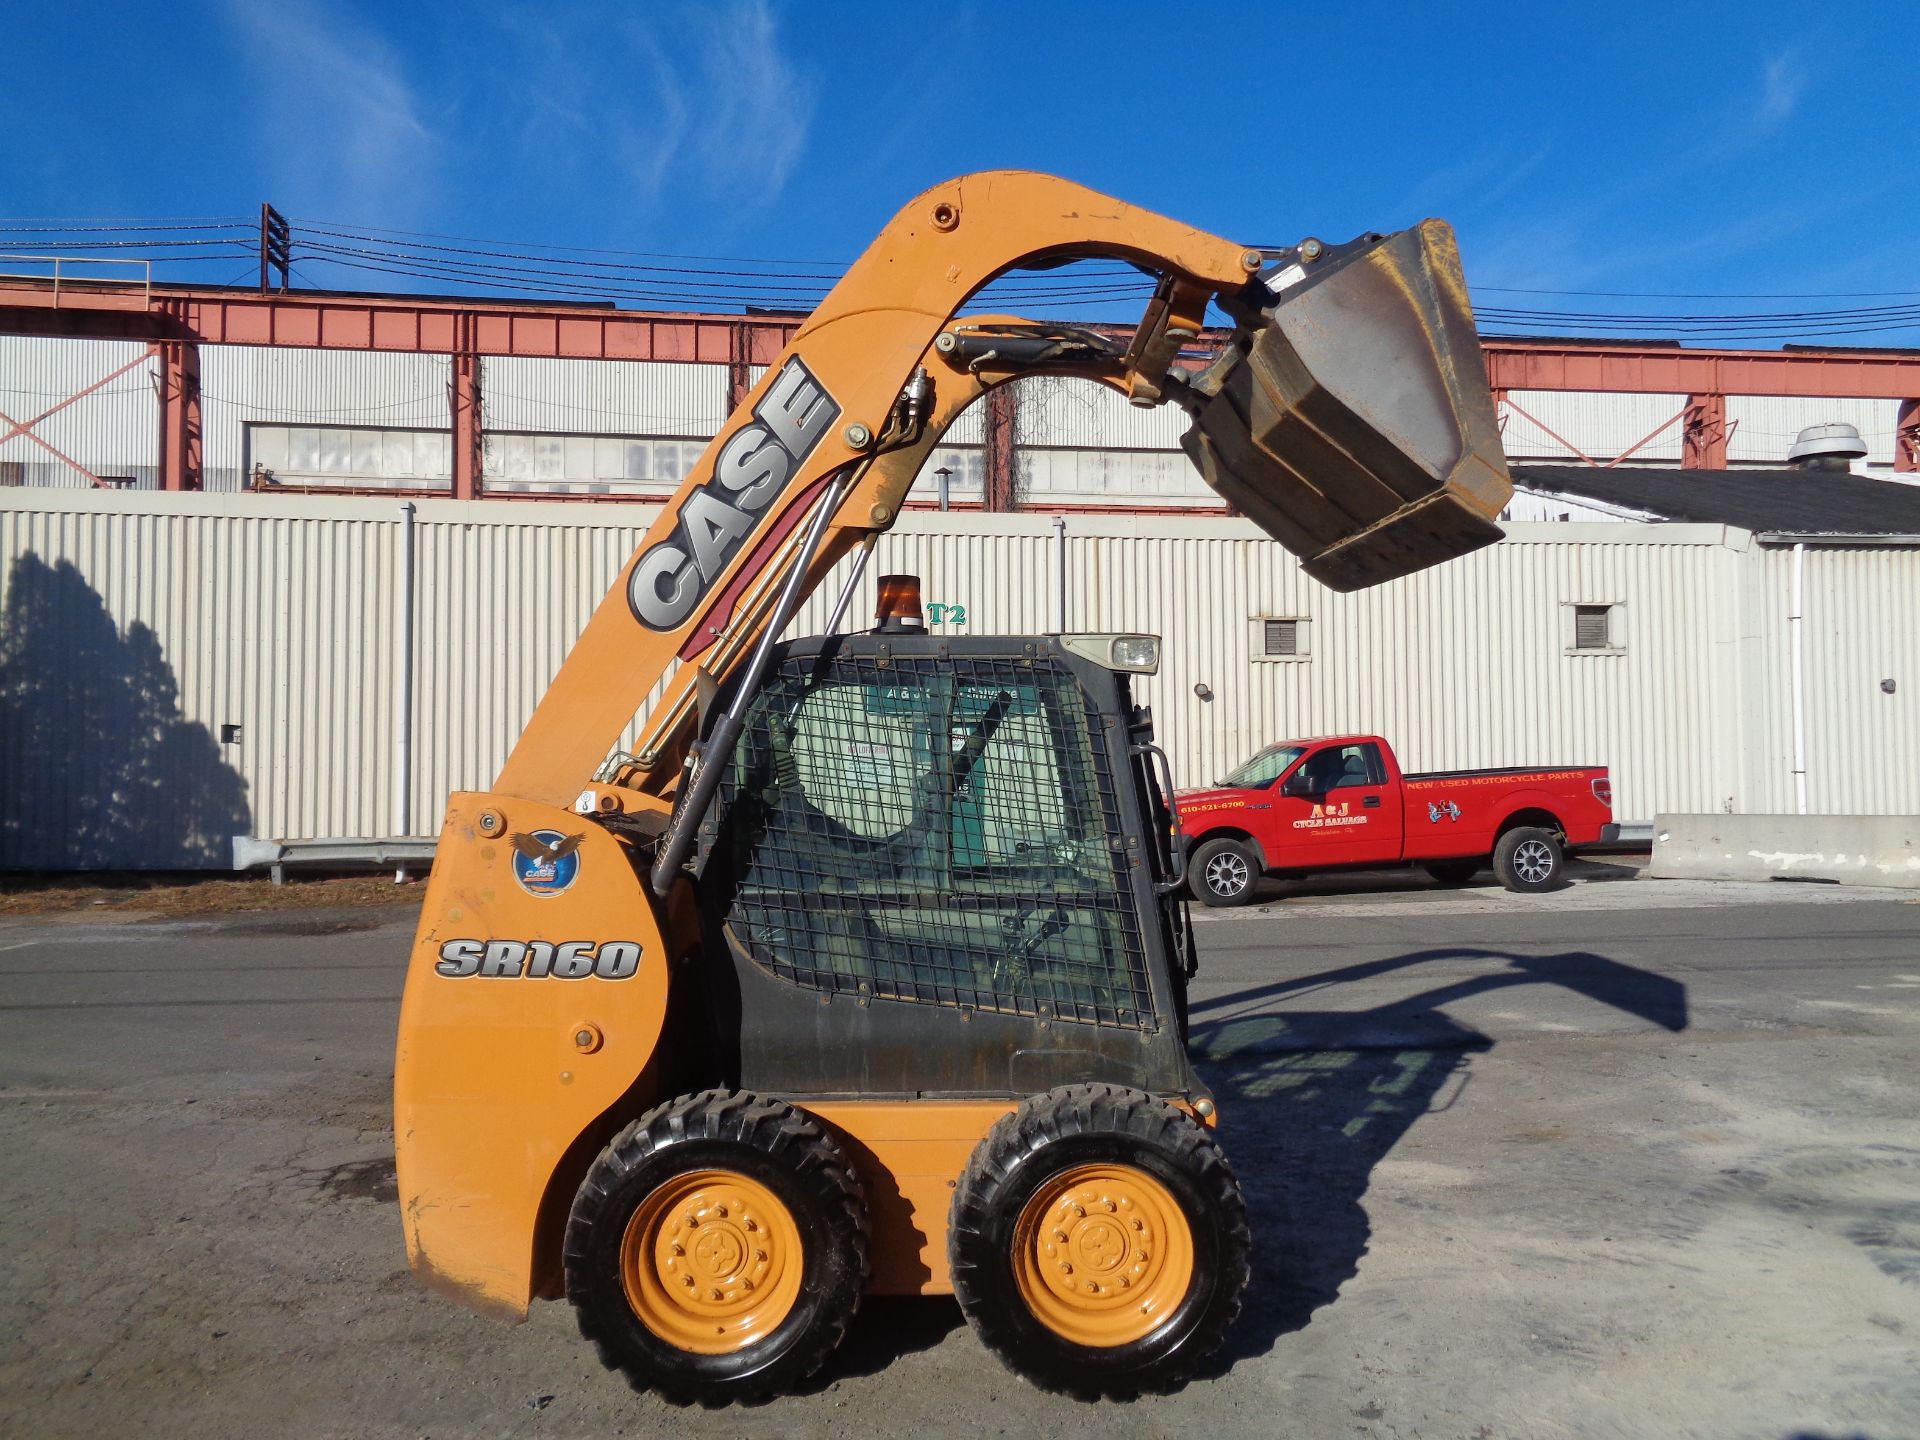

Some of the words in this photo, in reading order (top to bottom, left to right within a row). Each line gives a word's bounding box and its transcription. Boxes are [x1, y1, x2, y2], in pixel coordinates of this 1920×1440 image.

[630, 356, 840, 630] CASE
[926, 602, 967, 625] T2
[886, 688, 897, 699] A
[900, 687, 910, 699] &
[967, 687, 1018, 699] Salvae
[1407, 782, 1433, 790] NEW
[1440, 779, 1469, 788] USED
[1472, 774, 1543, 786] MOTORCYCLE
[1549, 771, 1584, 781] PARTS
[1181, 801, 1245, 814] 610-521-6700
[1311, 804, 1325, 819] A
[1326, 805, 1337, 816] &
[1338, 802, 1349, 816] J
[1292, 818, 1324, 829] CYCLE
[1325, 815, 1368, 827] SALVAGE
[525, 870, 555, 878] CASE
[435, 940, 642, 979] SR160
